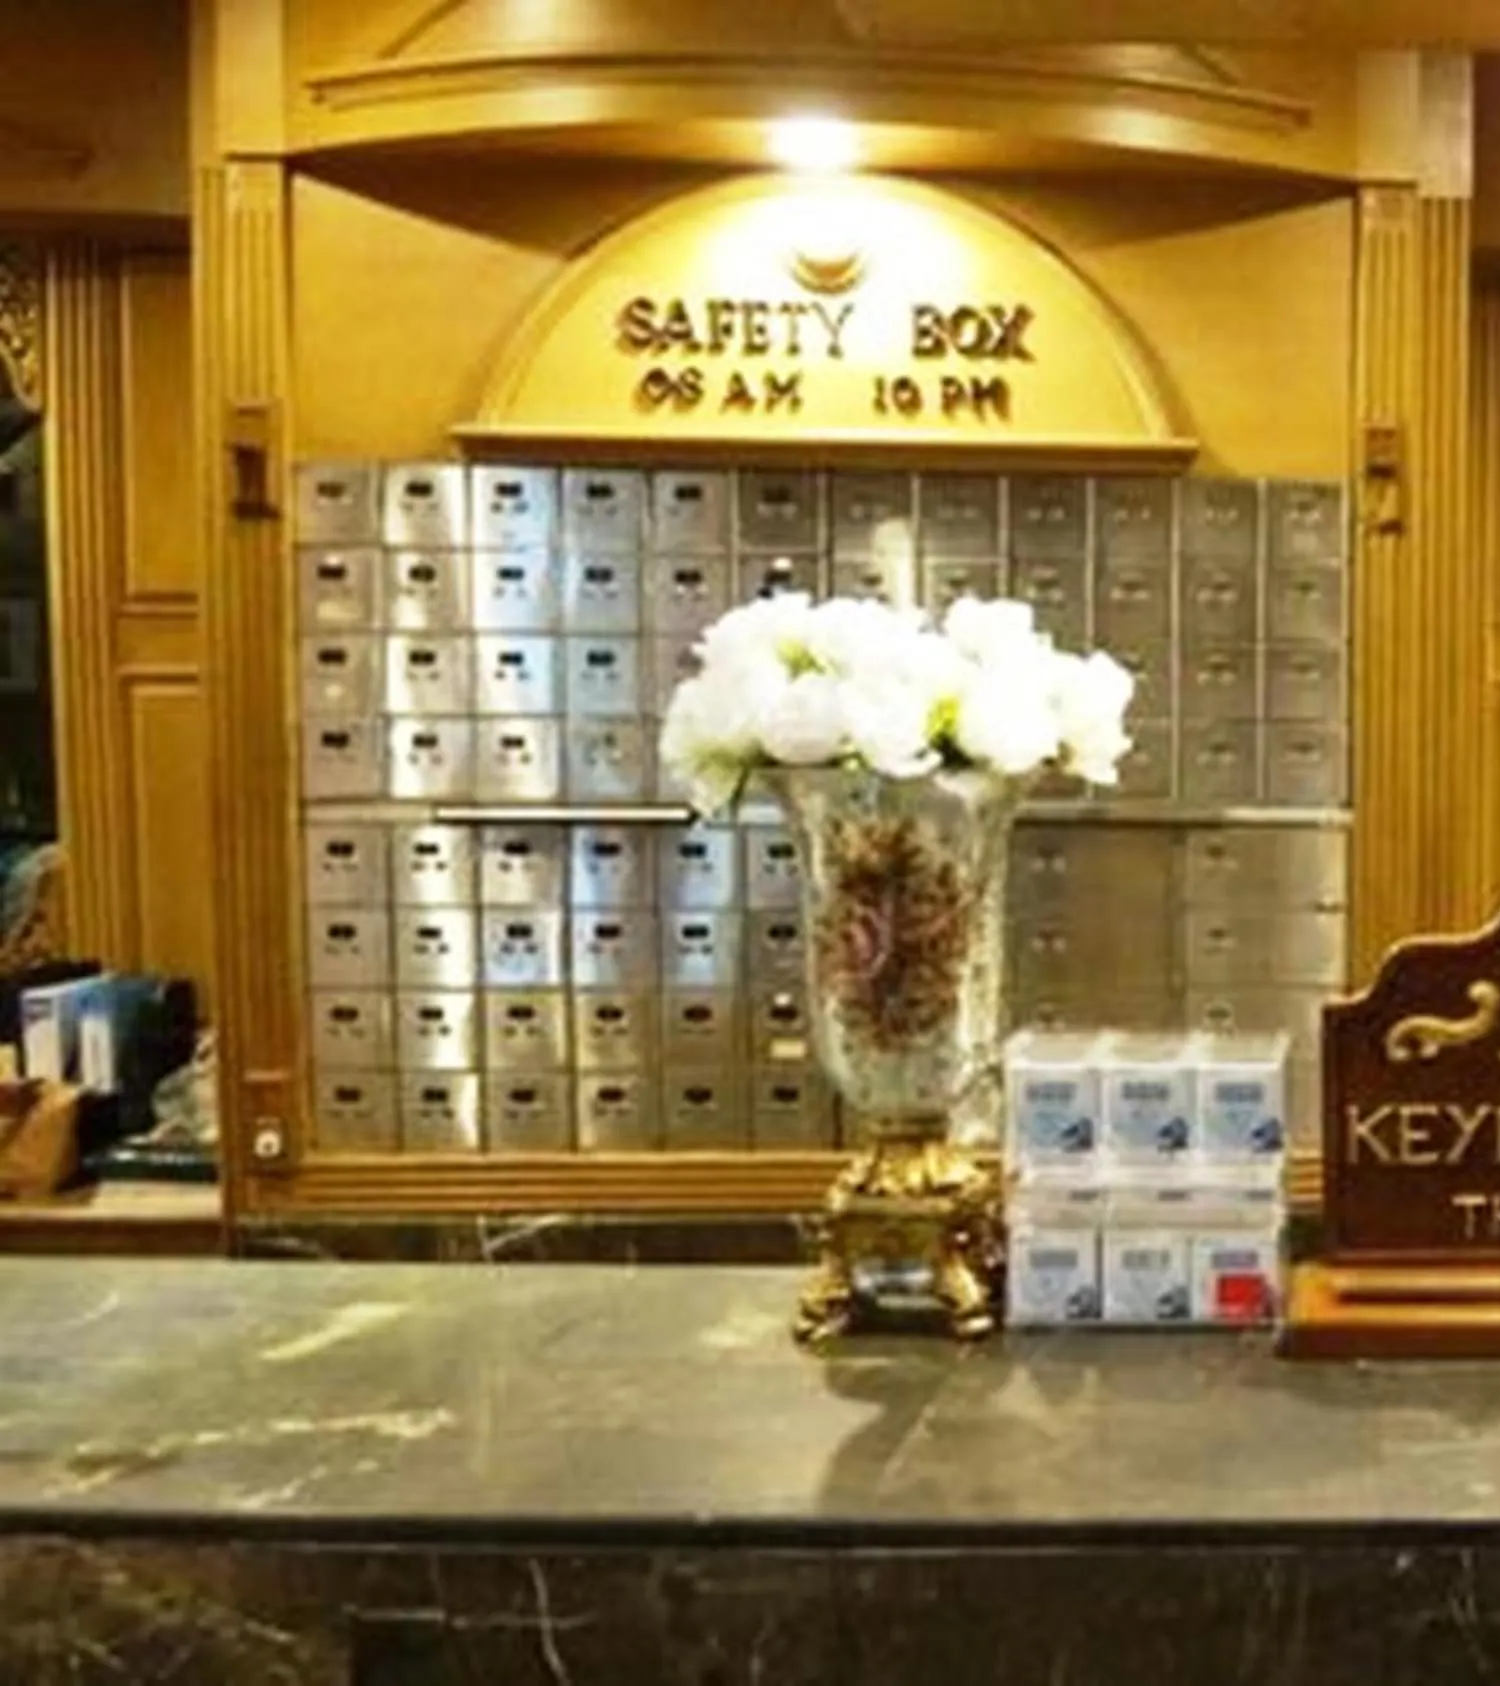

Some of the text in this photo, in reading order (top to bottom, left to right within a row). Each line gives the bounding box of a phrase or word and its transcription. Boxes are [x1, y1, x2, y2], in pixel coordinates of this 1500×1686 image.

[617, 296, 1036, 361] SAFETY BOX
[872, 374, 924, 417] 10
[939, 374, 1014, 421] PM
